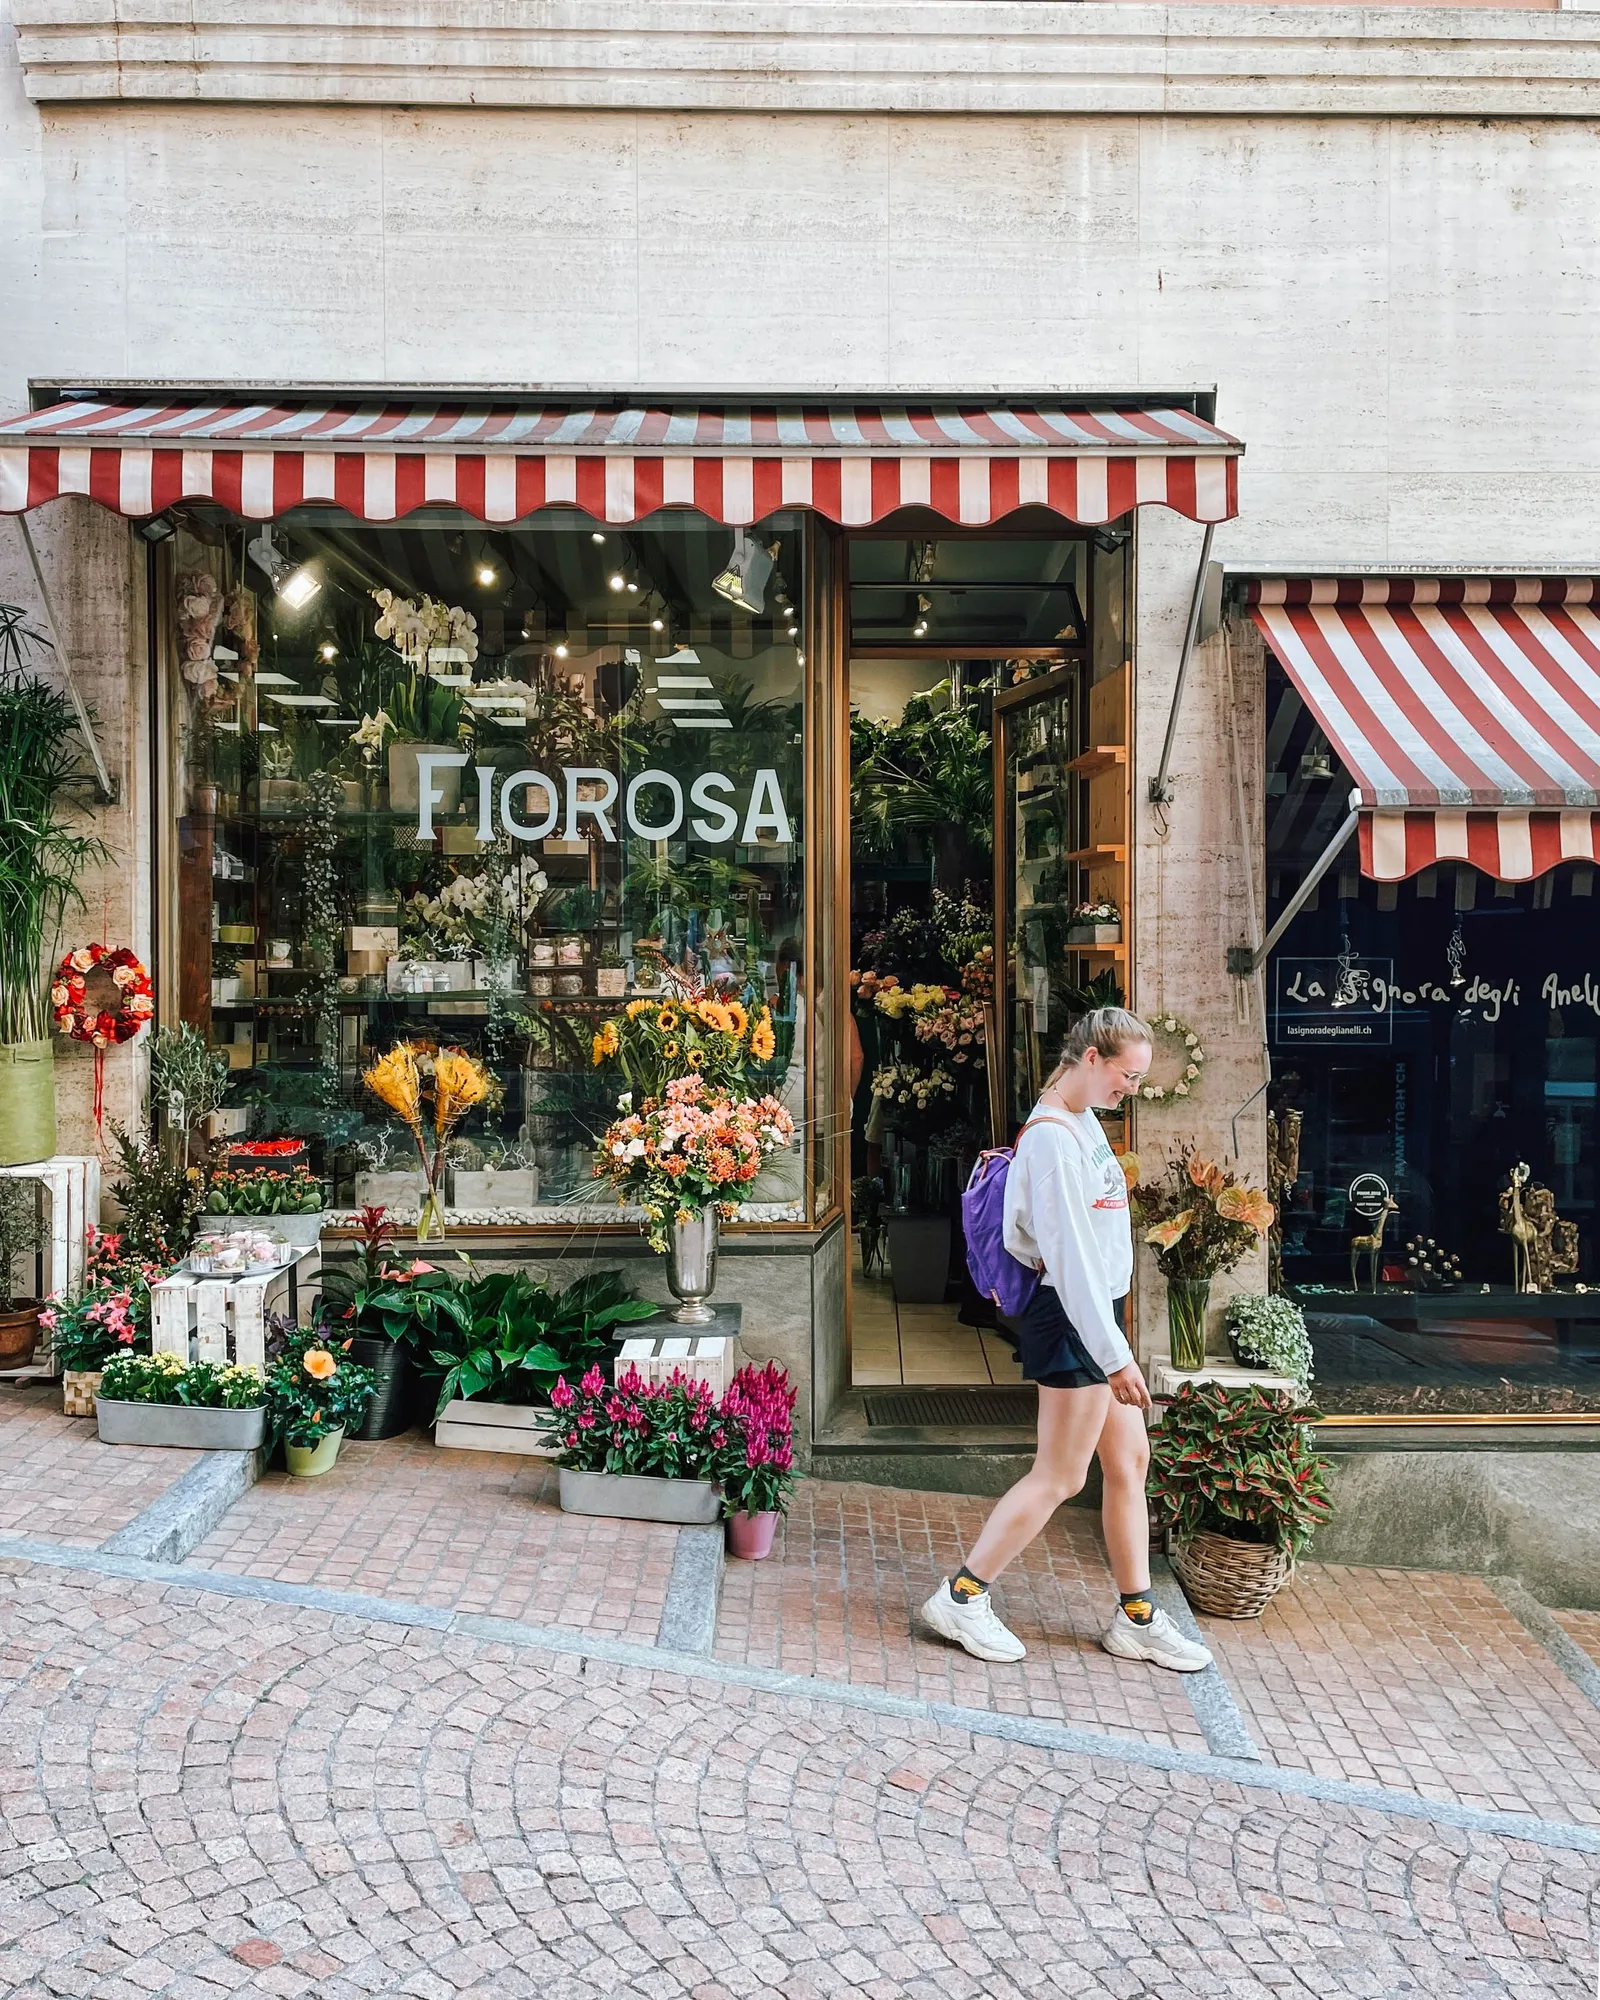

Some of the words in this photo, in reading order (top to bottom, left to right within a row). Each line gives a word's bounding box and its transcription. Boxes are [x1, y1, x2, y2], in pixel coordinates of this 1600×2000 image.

[416, 753, 793, 843] FIOROSA
[1286, 971, 1326, 1003] La
[1342, 970, 1450, 1013] Signora
[1464, 975, 1521, 1022] degli
[1287, 1025, 1372, 1037] lasignoradeglianelli.ch
